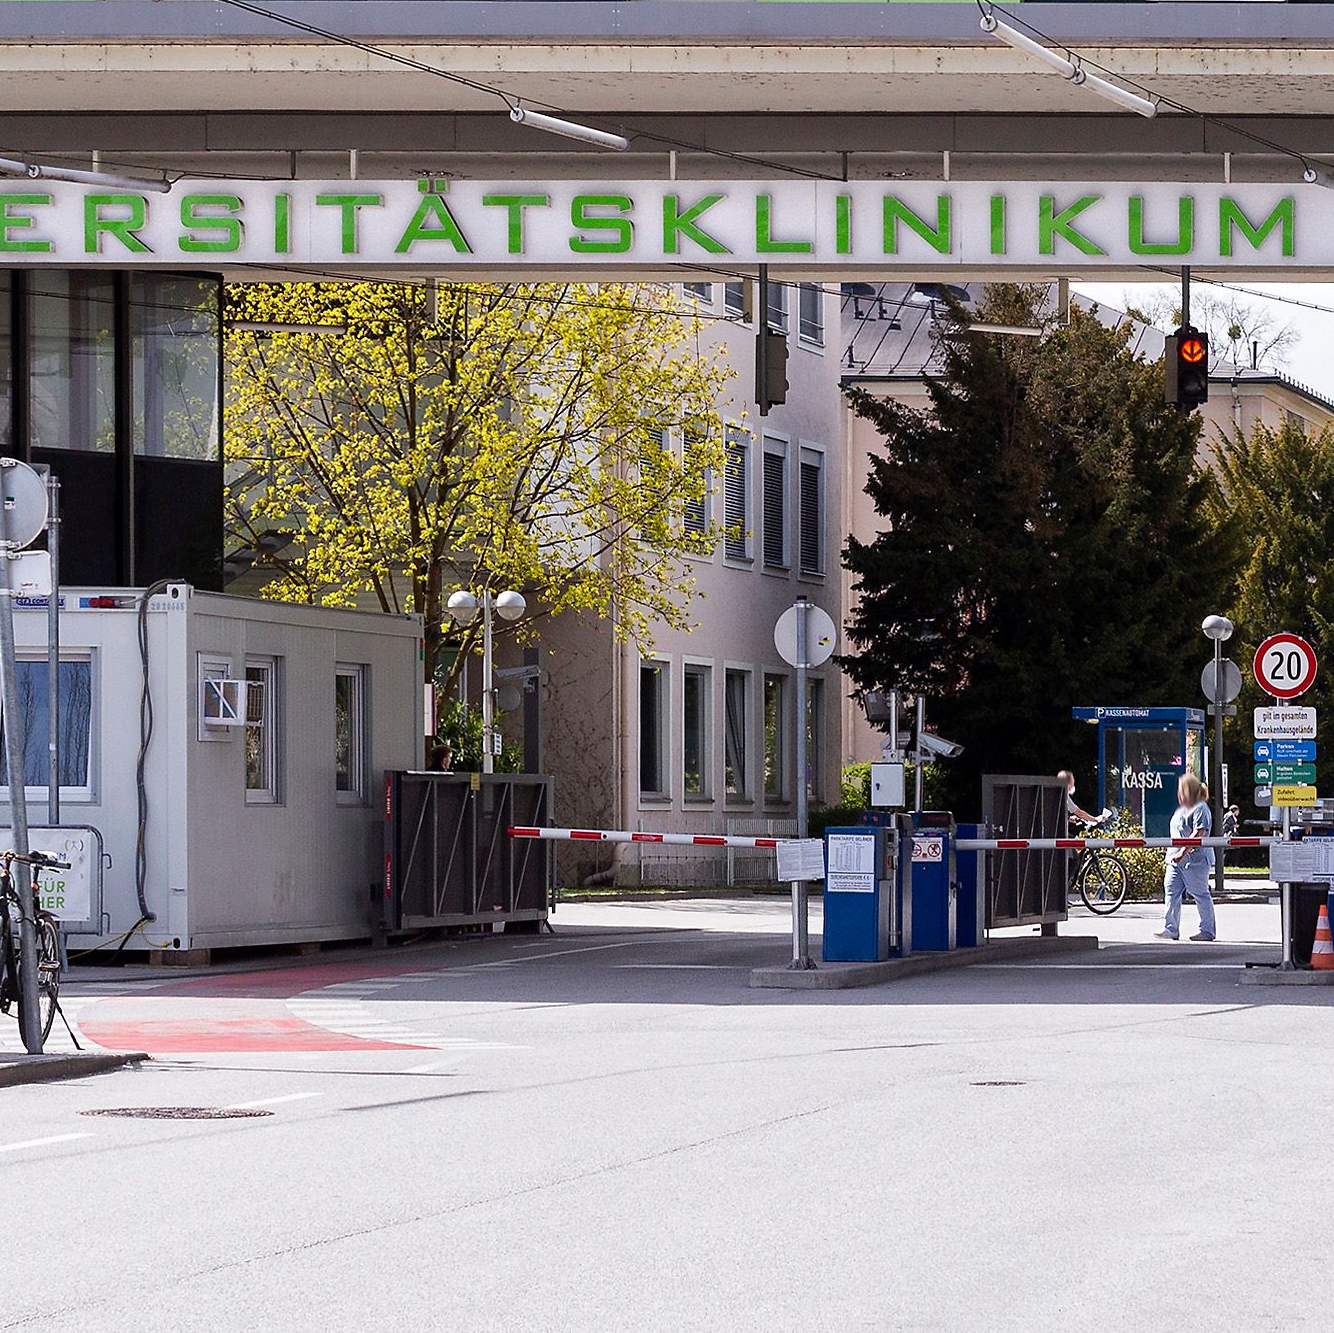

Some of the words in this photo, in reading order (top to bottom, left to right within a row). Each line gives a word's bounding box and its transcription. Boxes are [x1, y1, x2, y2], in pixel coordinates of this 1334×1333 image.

[1270, 651, 1302, 681] 20
[1106, 709, 1150, 717] KASSENAUTOMAT
[1262, 712, 1272, 722] gilt
[1273, 711, 1280, 720] im
[1281, 712, 1308, 722] gesamten
[1257, 725, 1314, 736] Krankenhausgelände
[1121, 772, 1163, 789] KASSA
